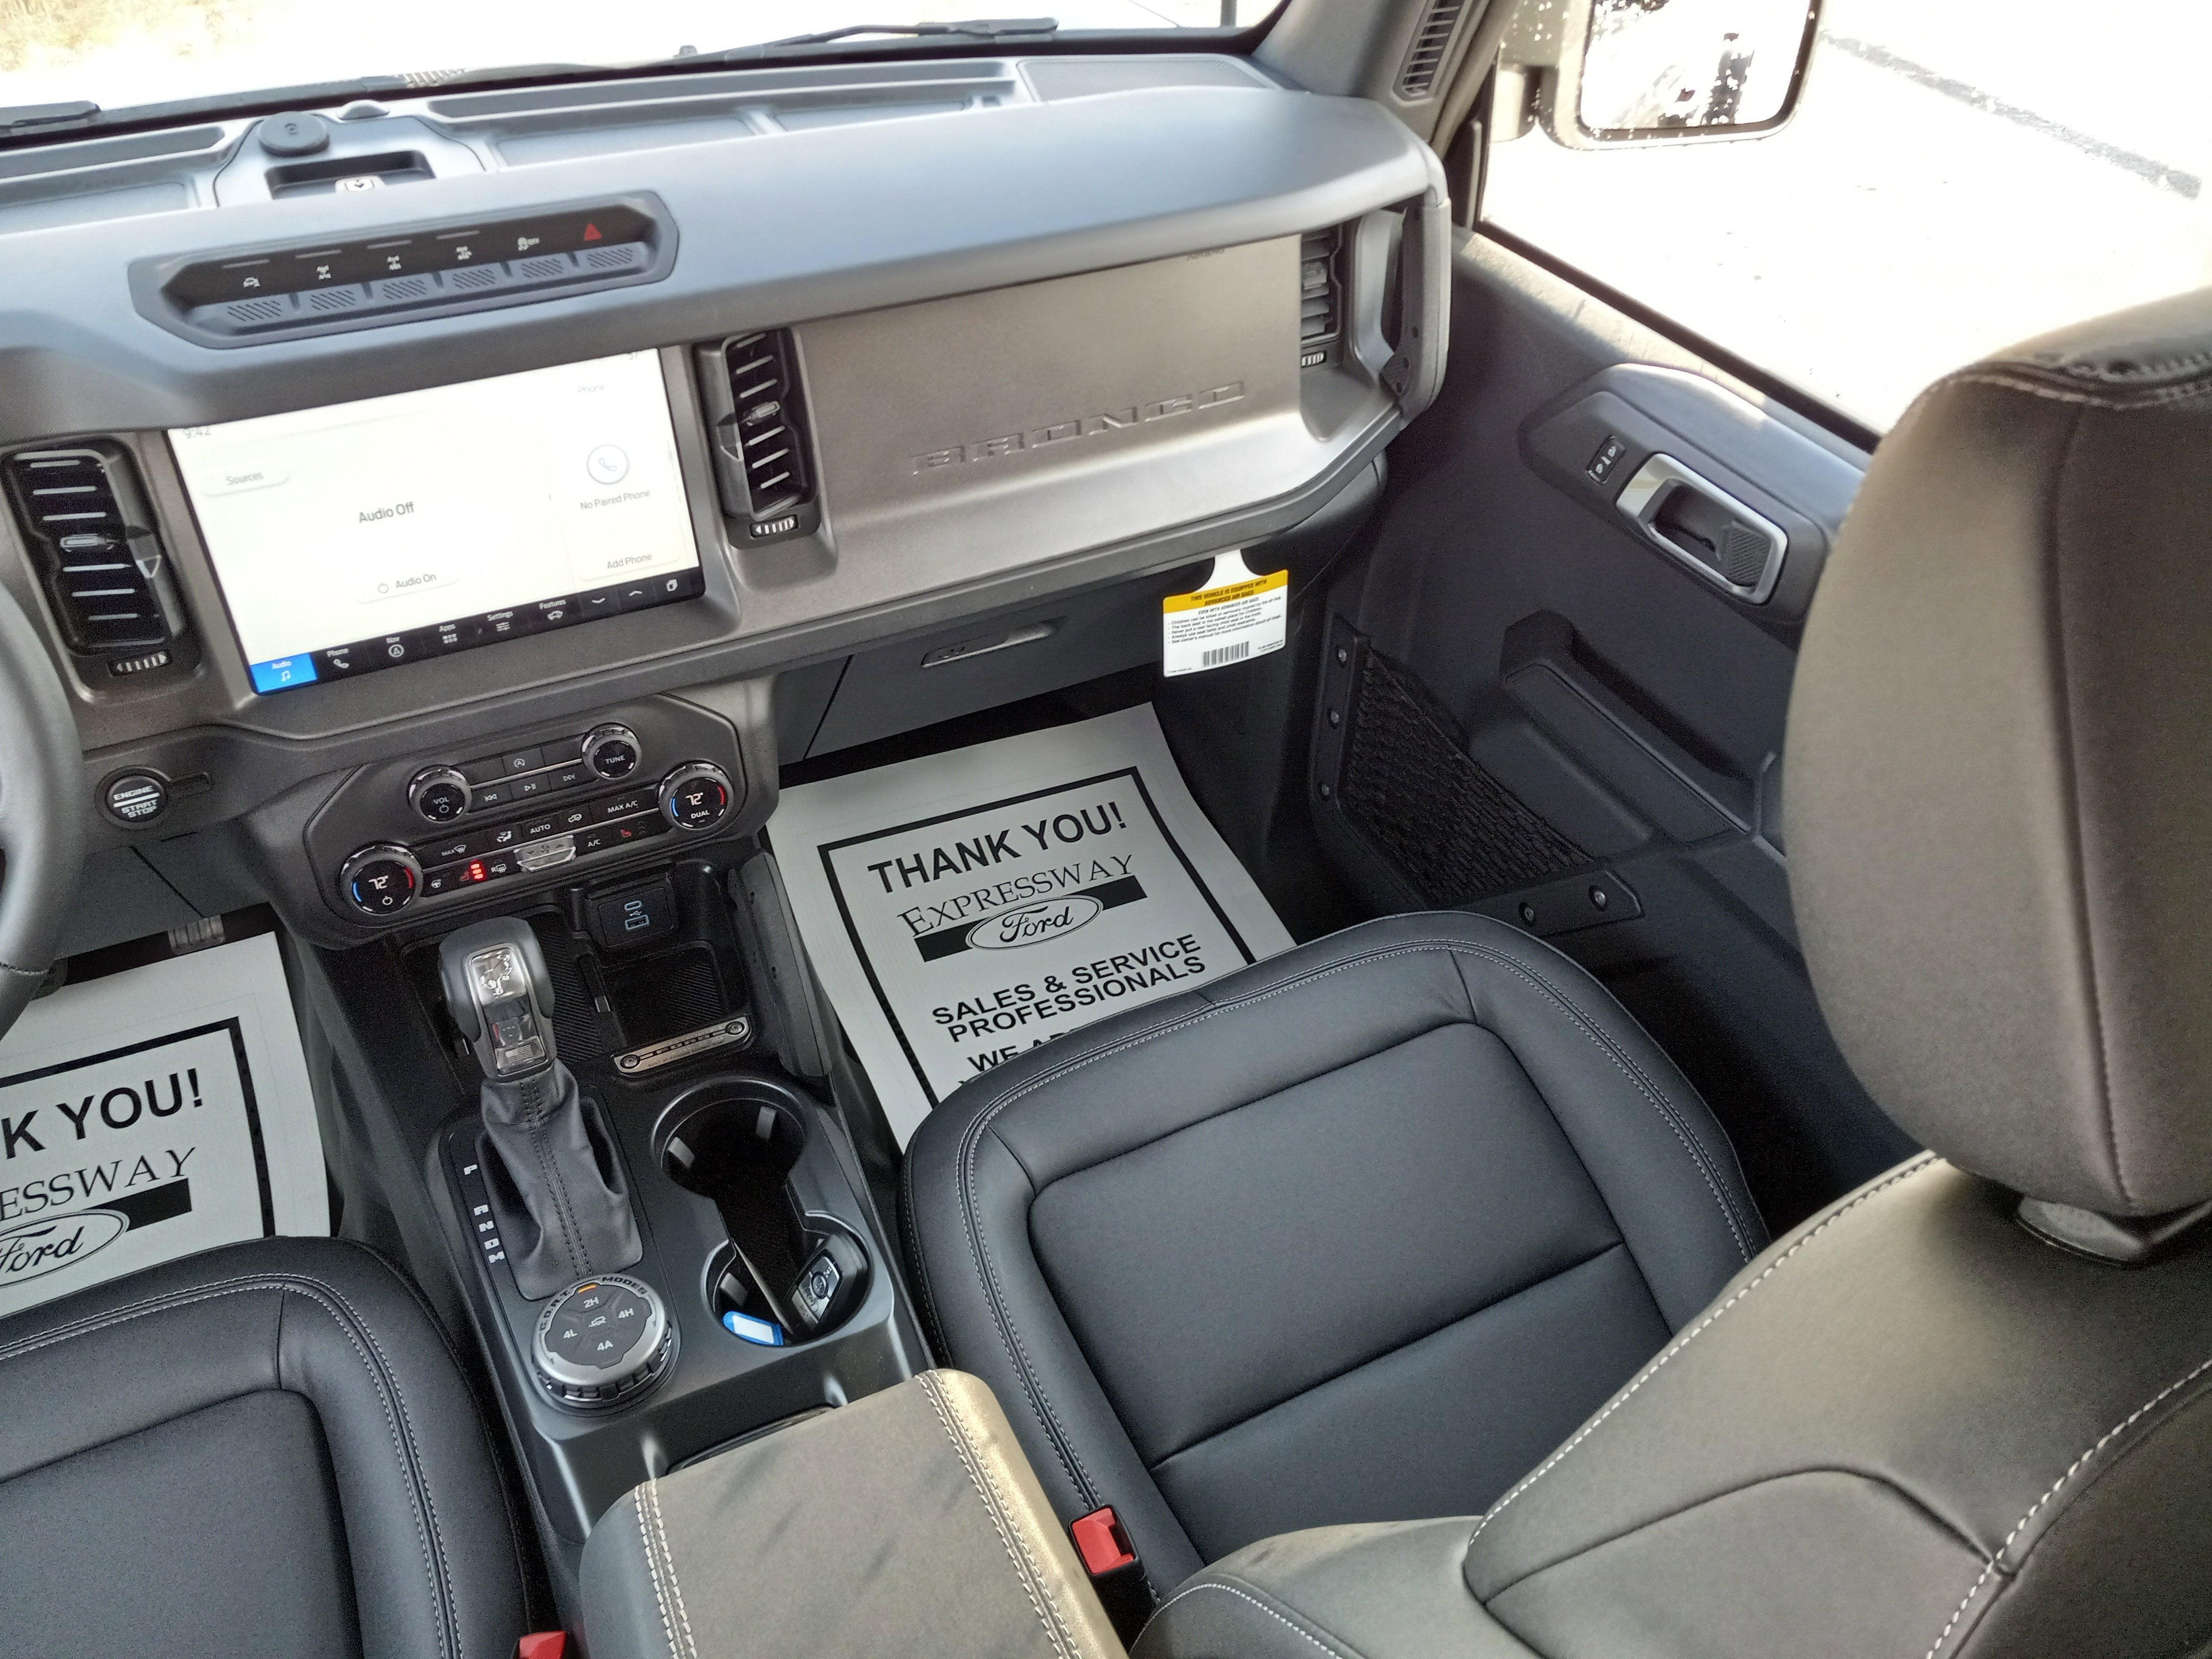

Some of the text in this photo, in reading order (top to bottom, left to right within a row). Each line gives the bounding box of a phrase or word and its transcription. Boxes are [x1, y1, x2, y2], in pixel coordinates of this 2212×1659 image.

[577, 385, 605, 395] Phone
[913, 382, 1244, 475] BRONCO
[226, 472, 264, 485] Sources
[594, 494, 622, 507] Paired
[623, 491, 650, 501] Phone
[359, 501, 414, 523] Audio Off
[607, 554, 652, 569] Add Phone
[396, 574, 436, 589] Audio On
[1203, 590, 1224, 599] VEHICLE
[1231, 584, 1254, 593] EQUIPPED
[1255, 579, 1266, 588] WITH
[539, 599, 566, 610] Features
[1204, 596, 1231, 606] ADVANCED
[487, 611, 514, 621] Settings
[439, 624, 456, 632] Apps
[326, 648, 349, 657] Phone
[272, 661, 292, 670] Audio
[605, 755, 625, 764] TUNE
[113, 785, 154, 800] ENGINE
[121, 799, 157, 814] START
[127, 805, 157, 817] STOP
[607, 800, 638, 813] MAX A/C
[691, 810, 710, 819] DUAL
[530, 824, 551, 834] AUTO
[867, 802, 1127, 893] THANK YOU!
[897, 854, 1132, 937] EXPRESSWAY
[1000, 906, 1074, 943] Ford
[933, 934, 1202, 1024] SALES & SERVICE
[949, 956, 1206, 1043] PROFESSIONALS
[55, 1068, 203, 1140] YOU!
[464, 1164, 478, 1175] P
[479, 1220, 494, 1232] N
[484, 1238, 500, 1250] D
[488, 1250, 505, 1263] M
[602, 1276, 647, 1295] MODES
[584, 1297, 599, 1308] 2H
[618, 1308, 634, 1319] 4H
[563, 1329, 577, 1338] 4L
[597, 1340, 613, 1351] 4A
